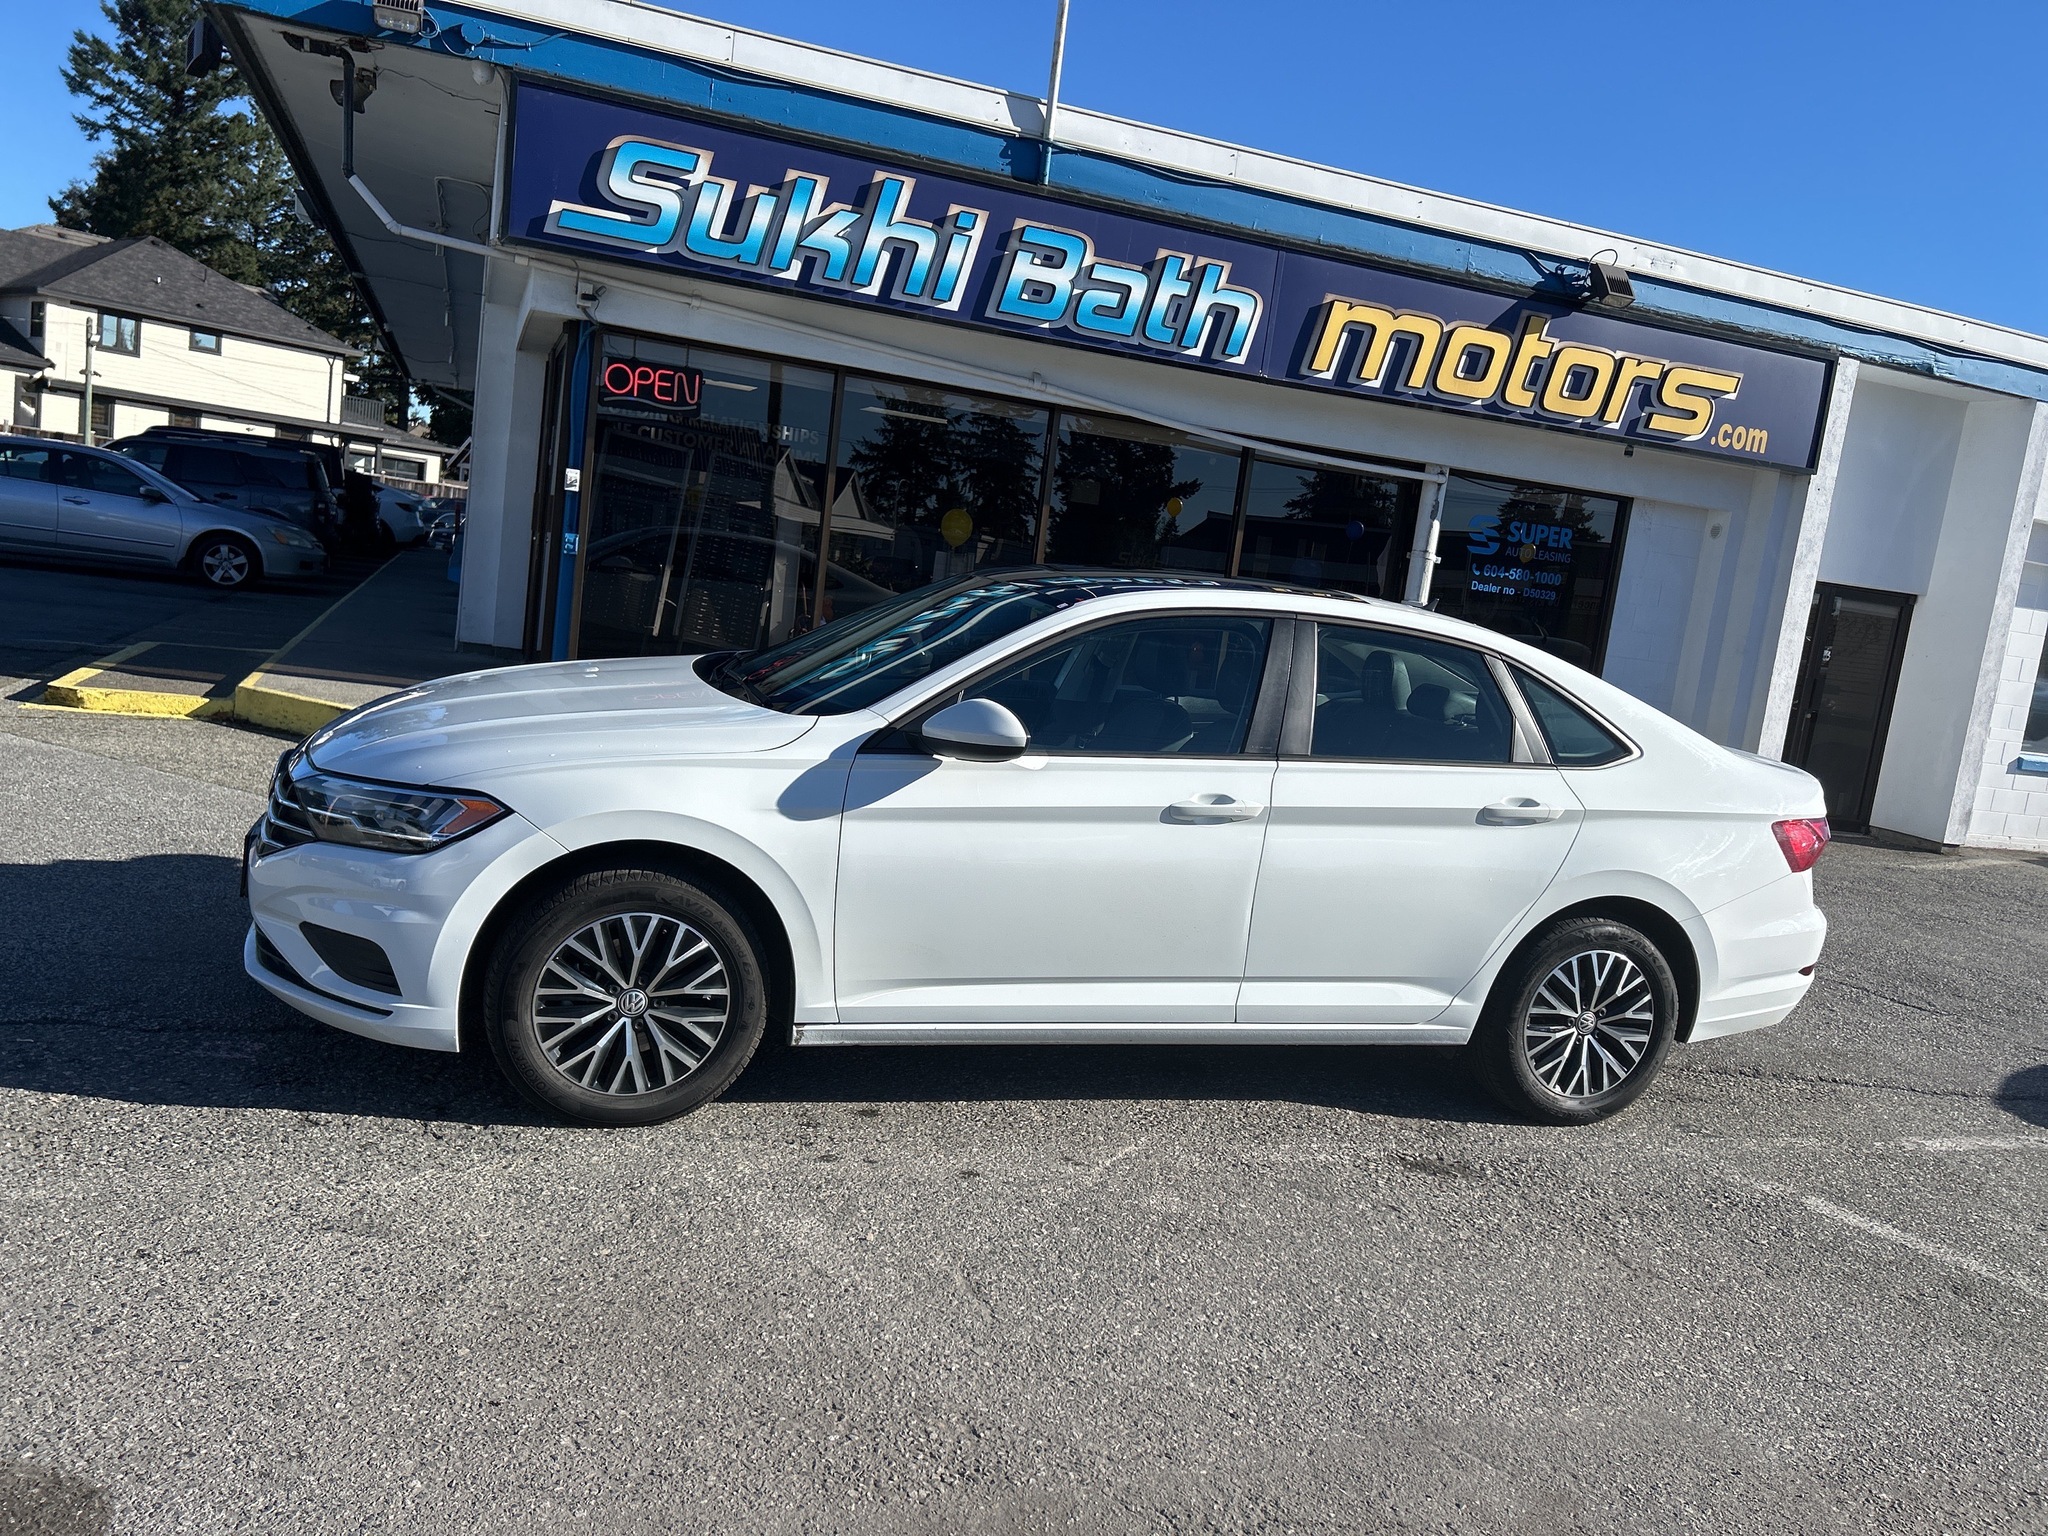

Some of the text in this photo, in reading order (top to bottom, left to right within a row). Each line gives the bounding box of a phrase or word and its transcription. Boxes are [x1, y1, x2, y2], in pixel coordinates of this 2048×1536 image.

[545, 136, 988, 310] Sukhi
[987, 220, 1261, 363] Bath
[1301, 296, 1742, 440] motors
[604, 363, 700, 404] OPEN
[637, 425, 733, 454] CUSTOMER
[1506, 521, 1573, 549] SUPER
[1505, 546, 1571, 564] AUTO LEASING
[1483, 564, 1562, 586] 604-580-1000
[1471, 580, 1502, 594] Dealer
[1502, 586, 1515, 595] no
[1523, 587, 1556, 601] D50329
